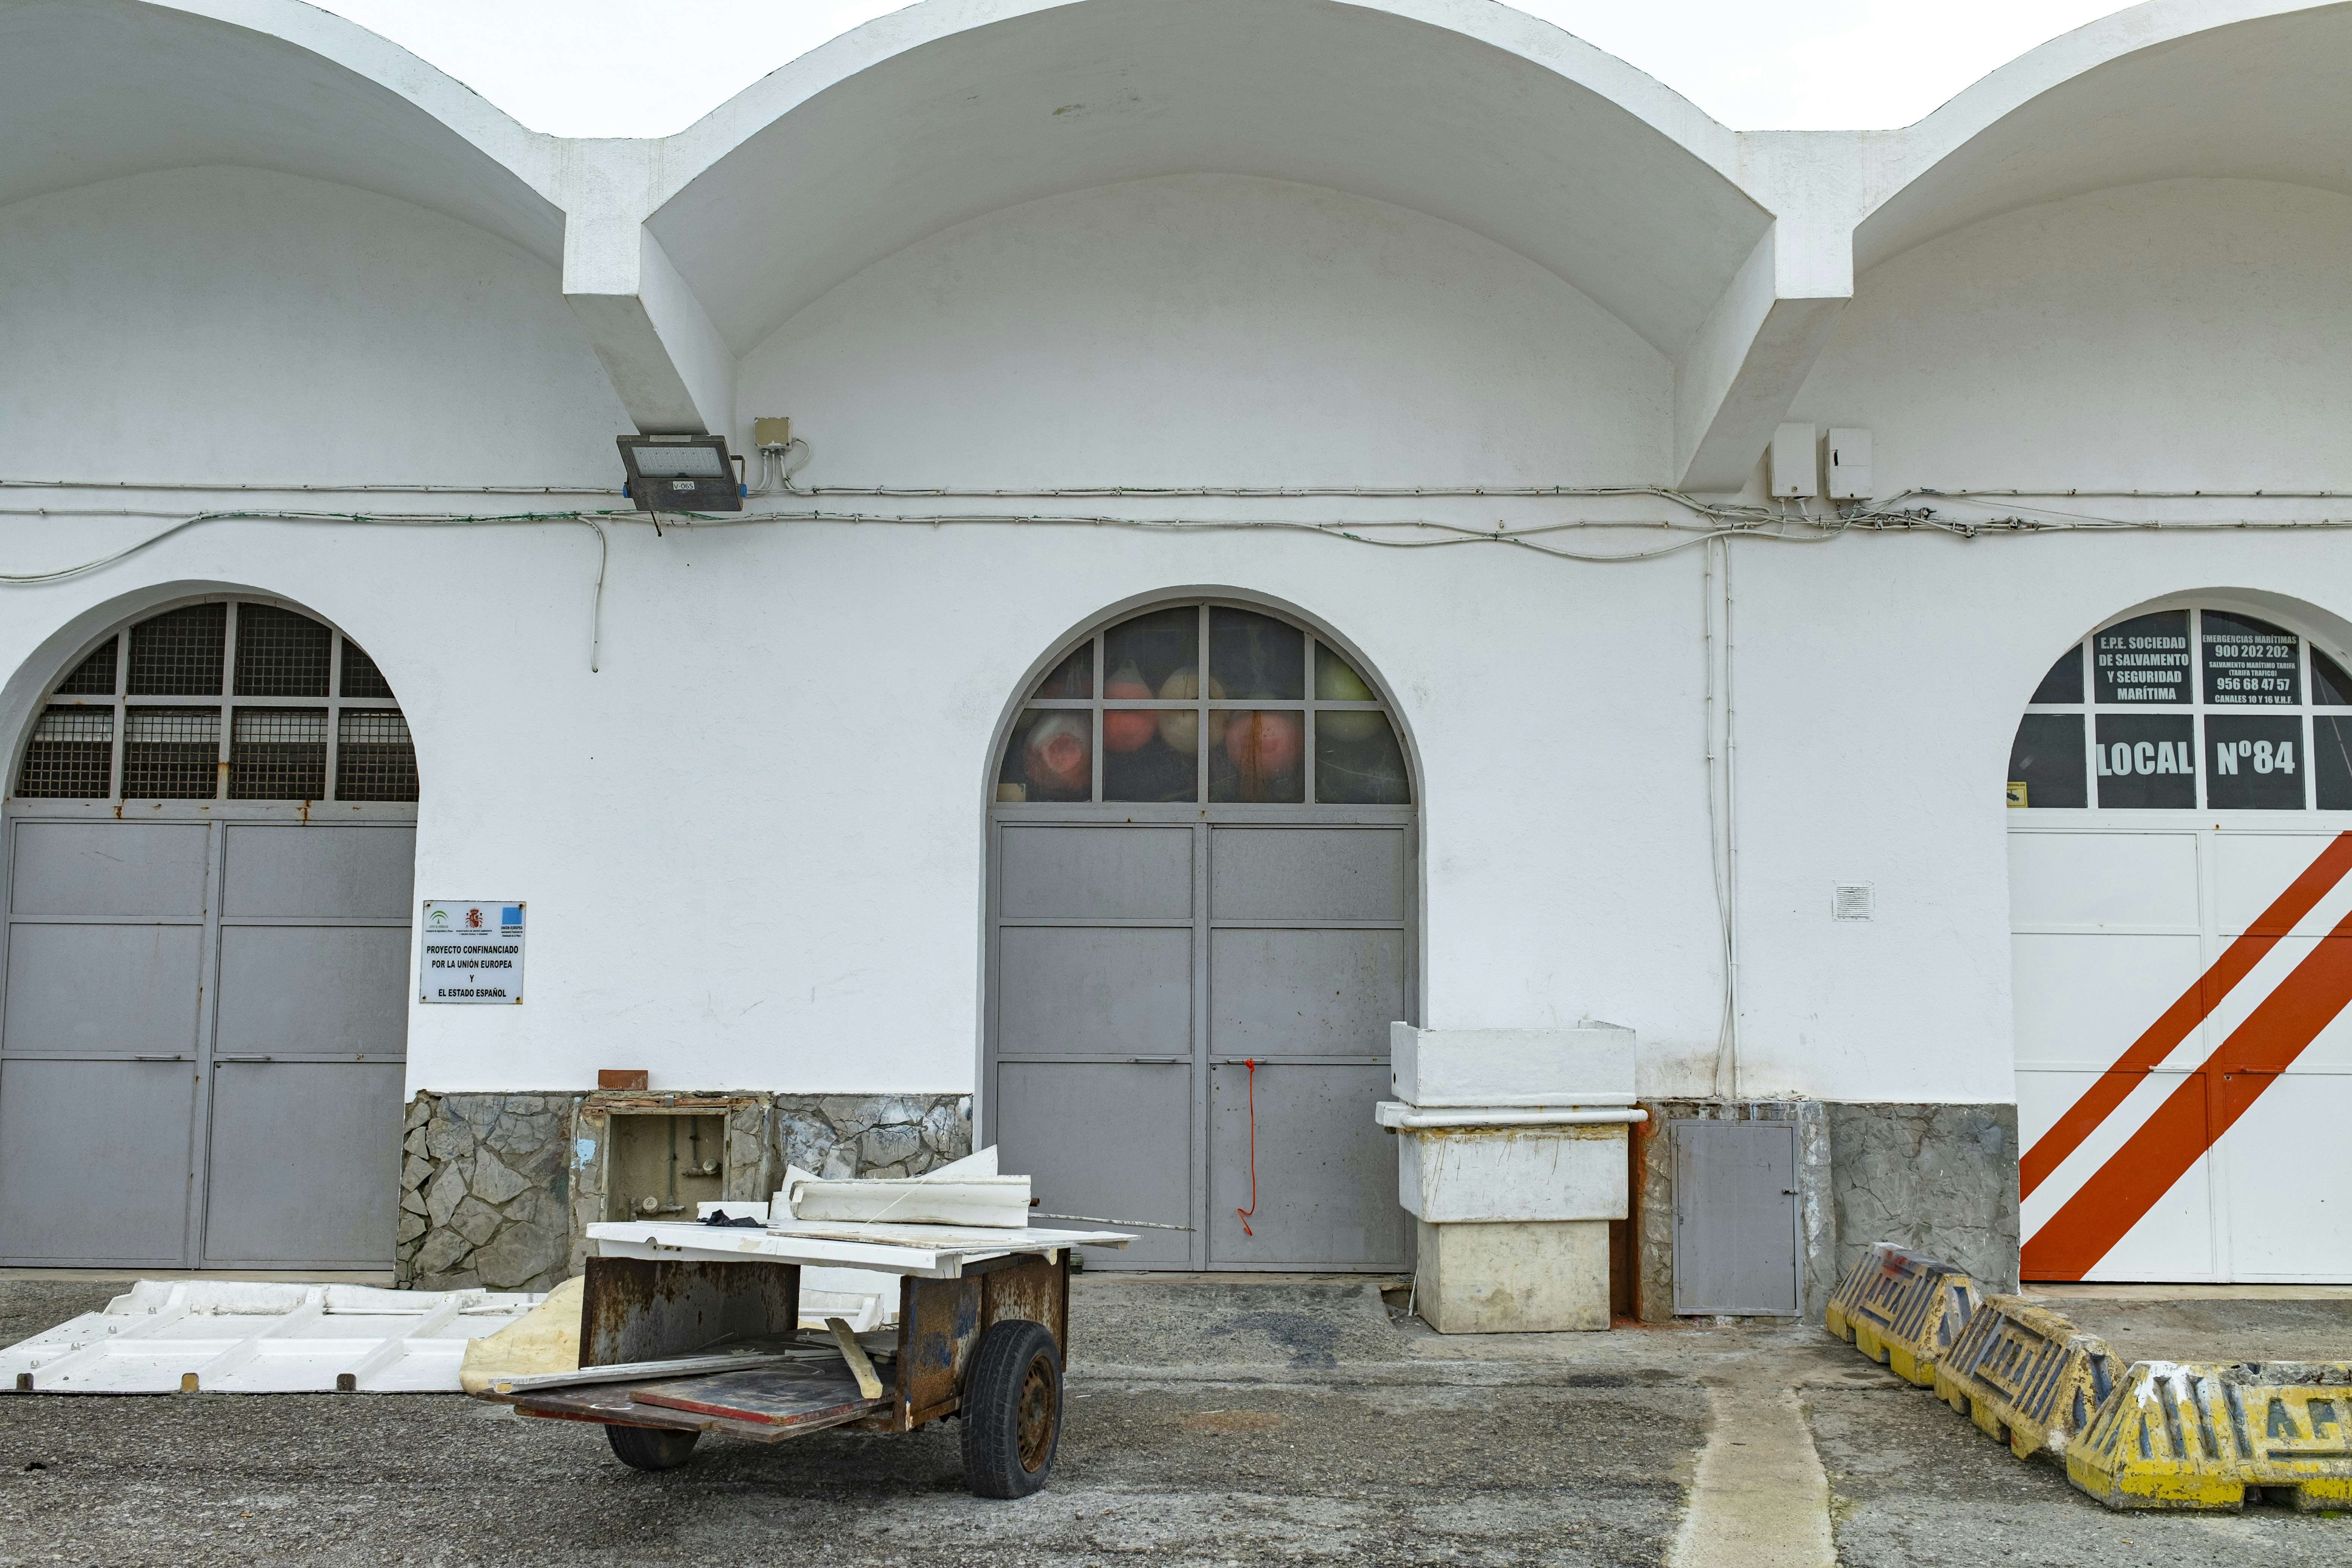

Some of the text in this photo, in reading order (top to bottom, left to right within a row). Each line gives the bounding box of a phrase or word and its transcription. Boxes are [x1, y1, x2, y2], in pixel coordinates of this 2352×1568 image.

[2101, 637, 2186, 649] E.P.E. SOCIEDAD
[2202, 634, 2296, 644] EMERGENCIAS MARÍTIMAS
[2215, 645, 2288, 657] 900 202 202
[2099, 654, 2189, 666] DE SALVAMENTO
[2107, 671, 2182, 683] Y SEGURIDAD
[2217, 678, 2289, 691] 956 68 47 57
[2117, 685, 2176, 700] MARÍTIMA
[2215, 695, 2247, 703] CANALES
[2096, 741, 2193, 776] LOCAL
[458, 959, 479, 968] UNIÓN
[476, 988, 506, 997] ESPAÑOL
